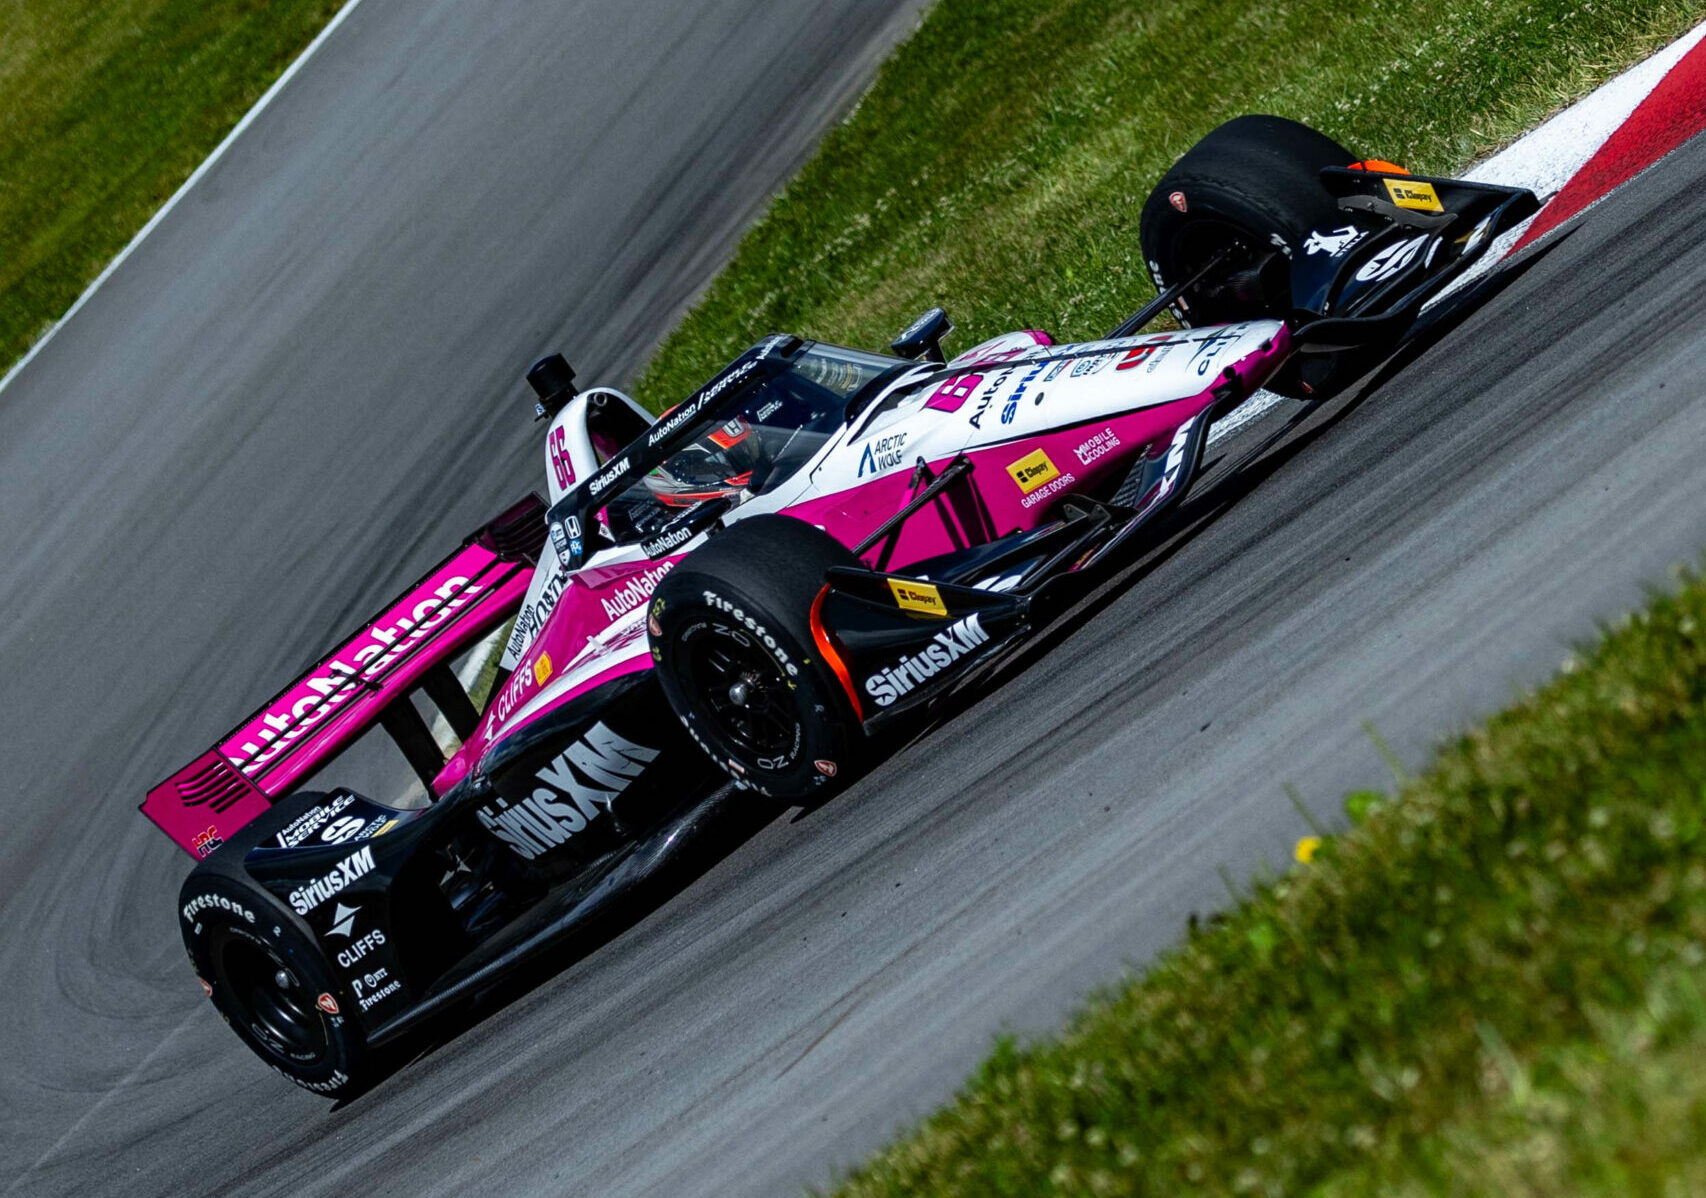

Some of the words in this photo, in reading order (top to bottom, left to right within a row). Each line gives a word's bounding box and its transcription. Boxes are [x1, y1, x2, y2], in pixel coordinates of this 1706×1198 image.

[1405, 189, 1433, 202] Clopay
[648, 403, 696, 446] AutoNation
[874, 432, 907, 455] ARCTIC
[1080, 427, 1115, 451] MOBILE
[549, 425, 576, 491] 66
[878, 449, 903, 470] WOLF
[1088, 436, 1121, 462] COOLING
[589, 457, 630, 496] SiriusXM
[1025, 461, 1048, 478] Clopay
[1021, 485, 1052, 508] GARAGE
[1049, 473, 1075, 492] DOORS
[643, 527, 692, 557] AutoNation
[601, 560, 674, 621] AutoNation
[908, 591, 937, 606] Clopay
[507, 604, 535, 661] AutoNation
[702, 590, 798, 677] Firestone
[222, 576, 486, 775] AutoNation
[865, 612, 990, 707] SiriusXM
[497, 659, 532, 720] CLIFFS
[476, 720, 661, 860] SiriusXM
[282, 806, 322, 836] AutoNation
[285, 795, 344, 843] MOBILE
[287, 794, 356, 848] SERVICE
[289, 845, 376, 916] SiriusXM
[183, 893, 256, 924] Firestone
[337, 929, 386, 968] CLIFFS
[359, 980, 402, 1011] Firestone
